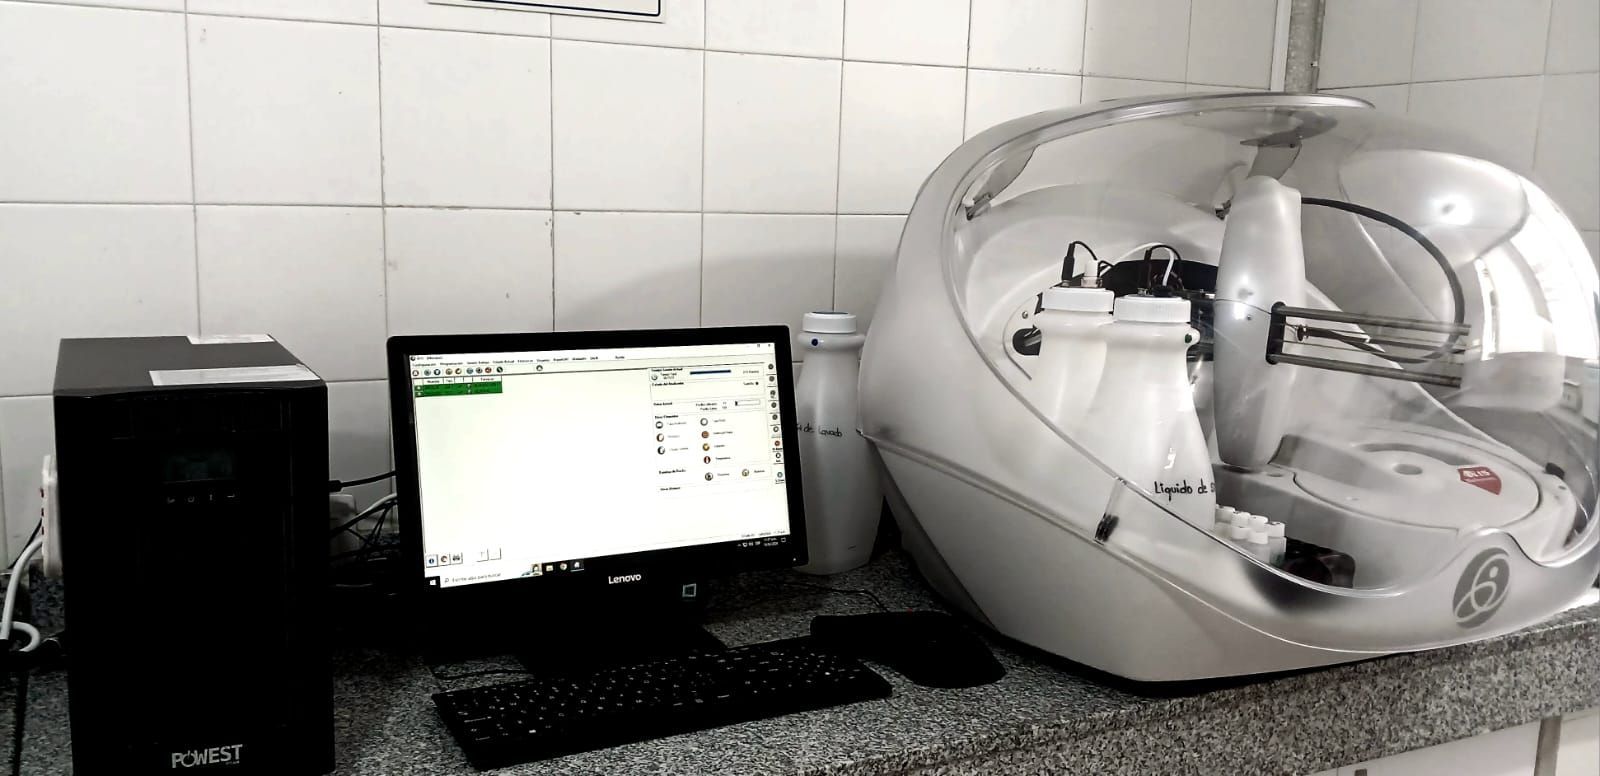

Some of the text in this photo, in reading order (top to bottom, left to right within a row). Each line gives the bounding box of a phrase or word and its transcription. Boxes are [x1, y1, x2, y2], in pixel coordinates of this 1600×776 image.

[1197, 478, 1208, 494] de
[608, 574, 642, 585] Lenovo
[171, 744, 243, 769] POWEST
